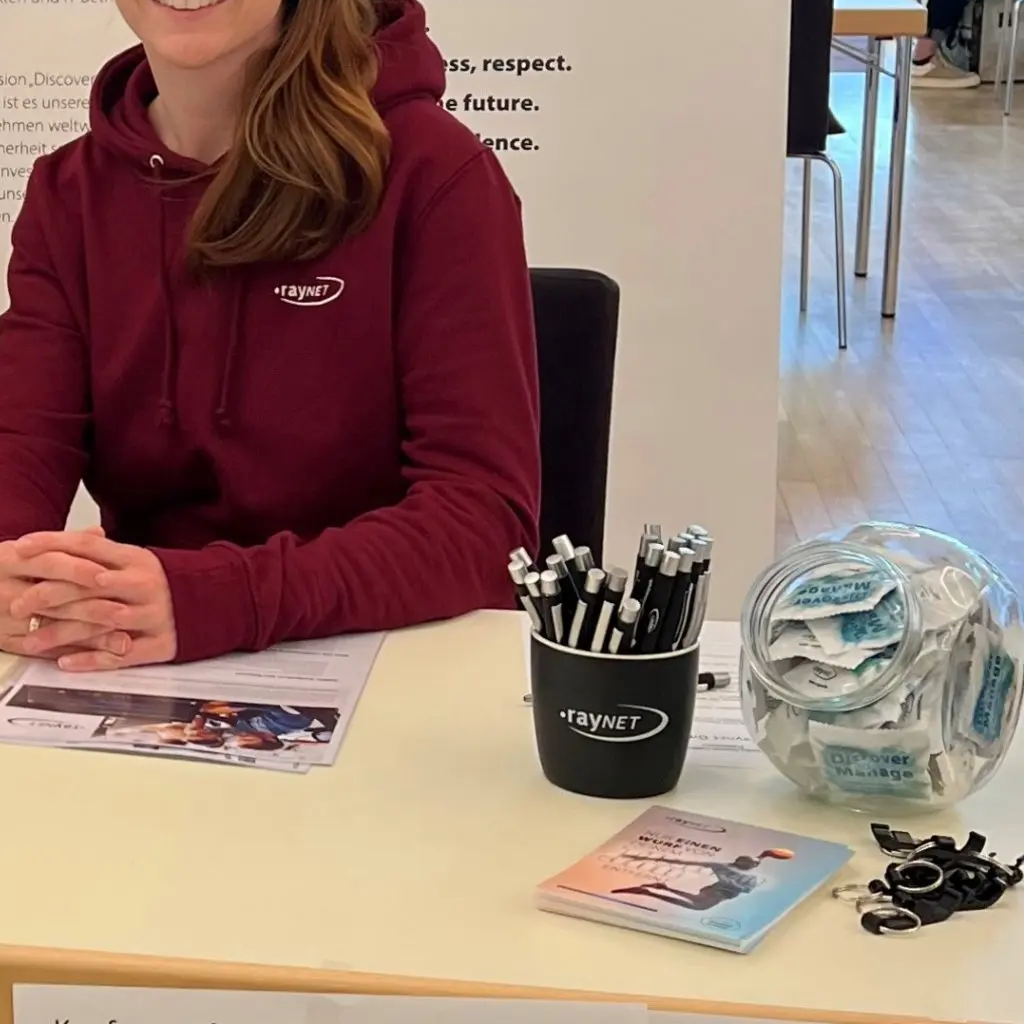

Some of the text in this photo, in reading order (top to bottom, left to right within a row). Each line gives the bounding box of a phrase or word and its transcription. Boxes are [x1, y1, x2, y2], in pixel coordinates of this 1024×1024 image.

[482, 55, 572, 76] respect.
[3, 95, 18, 109] ist
[22, 98, 38, 109] es
[463, 93, 540, 112] future.
